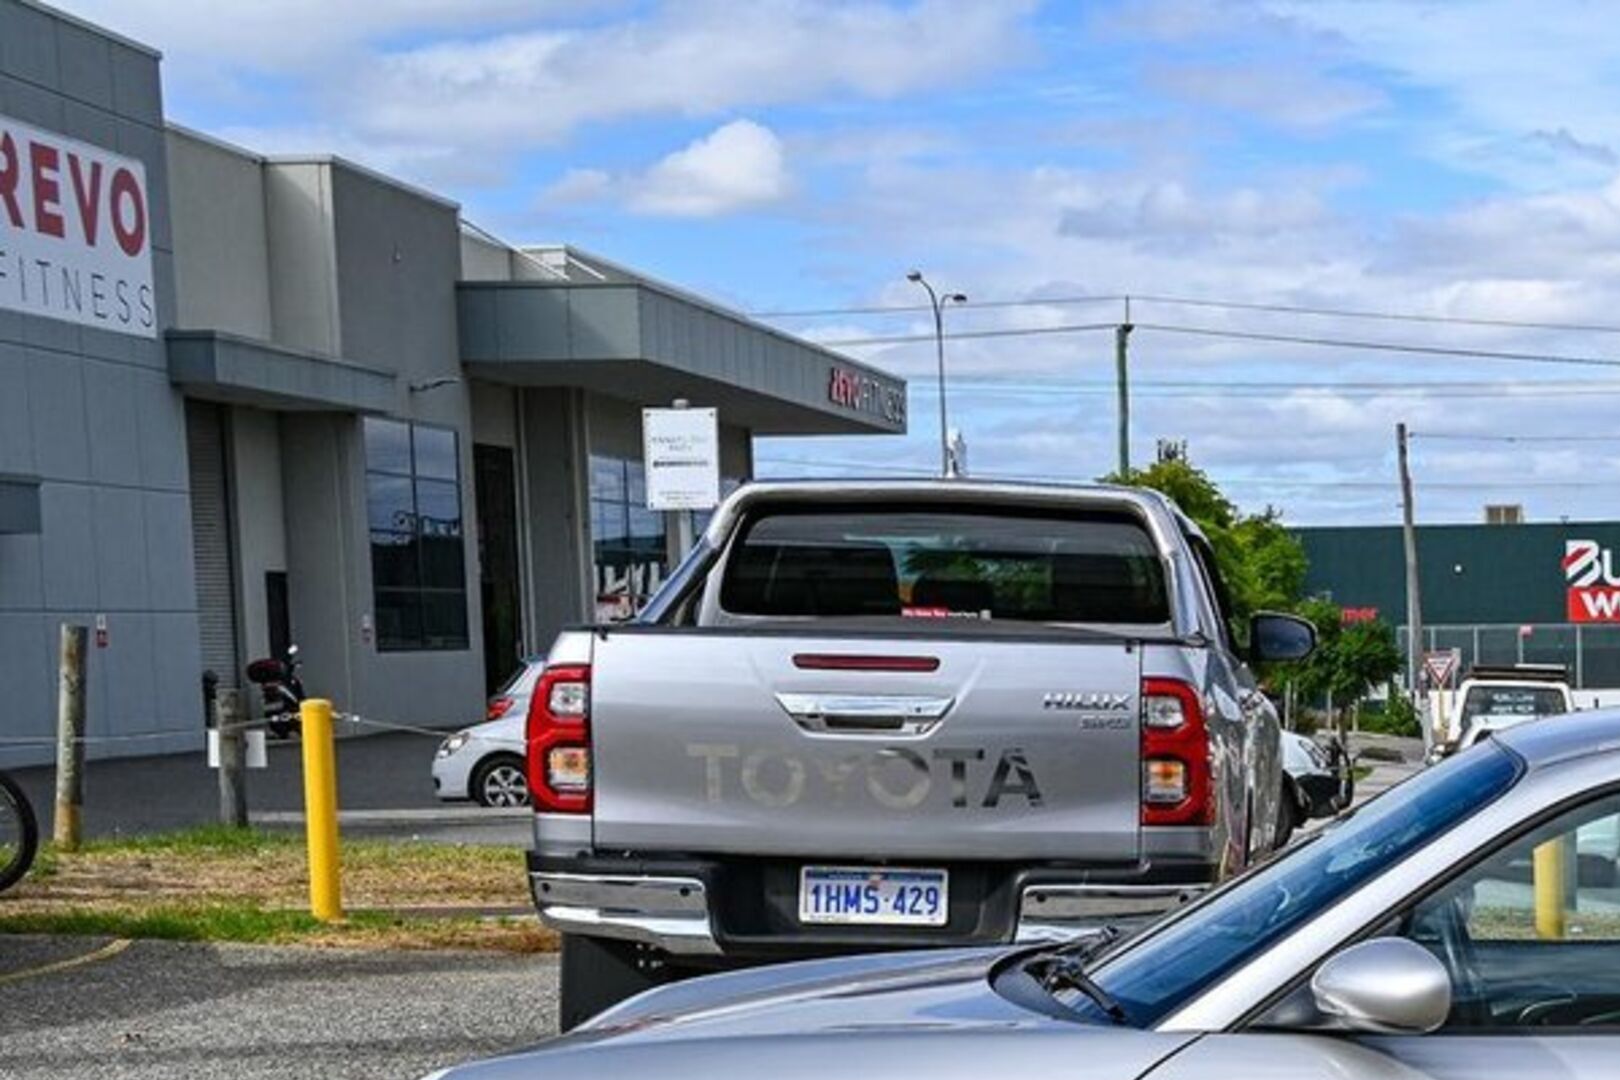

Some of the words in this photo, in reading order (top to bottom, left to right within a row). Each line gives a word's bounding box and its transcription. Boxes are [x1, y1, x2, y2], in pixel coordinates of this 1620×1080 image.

[0, 131, 146, 257] REVO
[1043, 693, 1131, 711] HILUX
[686, 744, 1042, 809] TOYOTA
